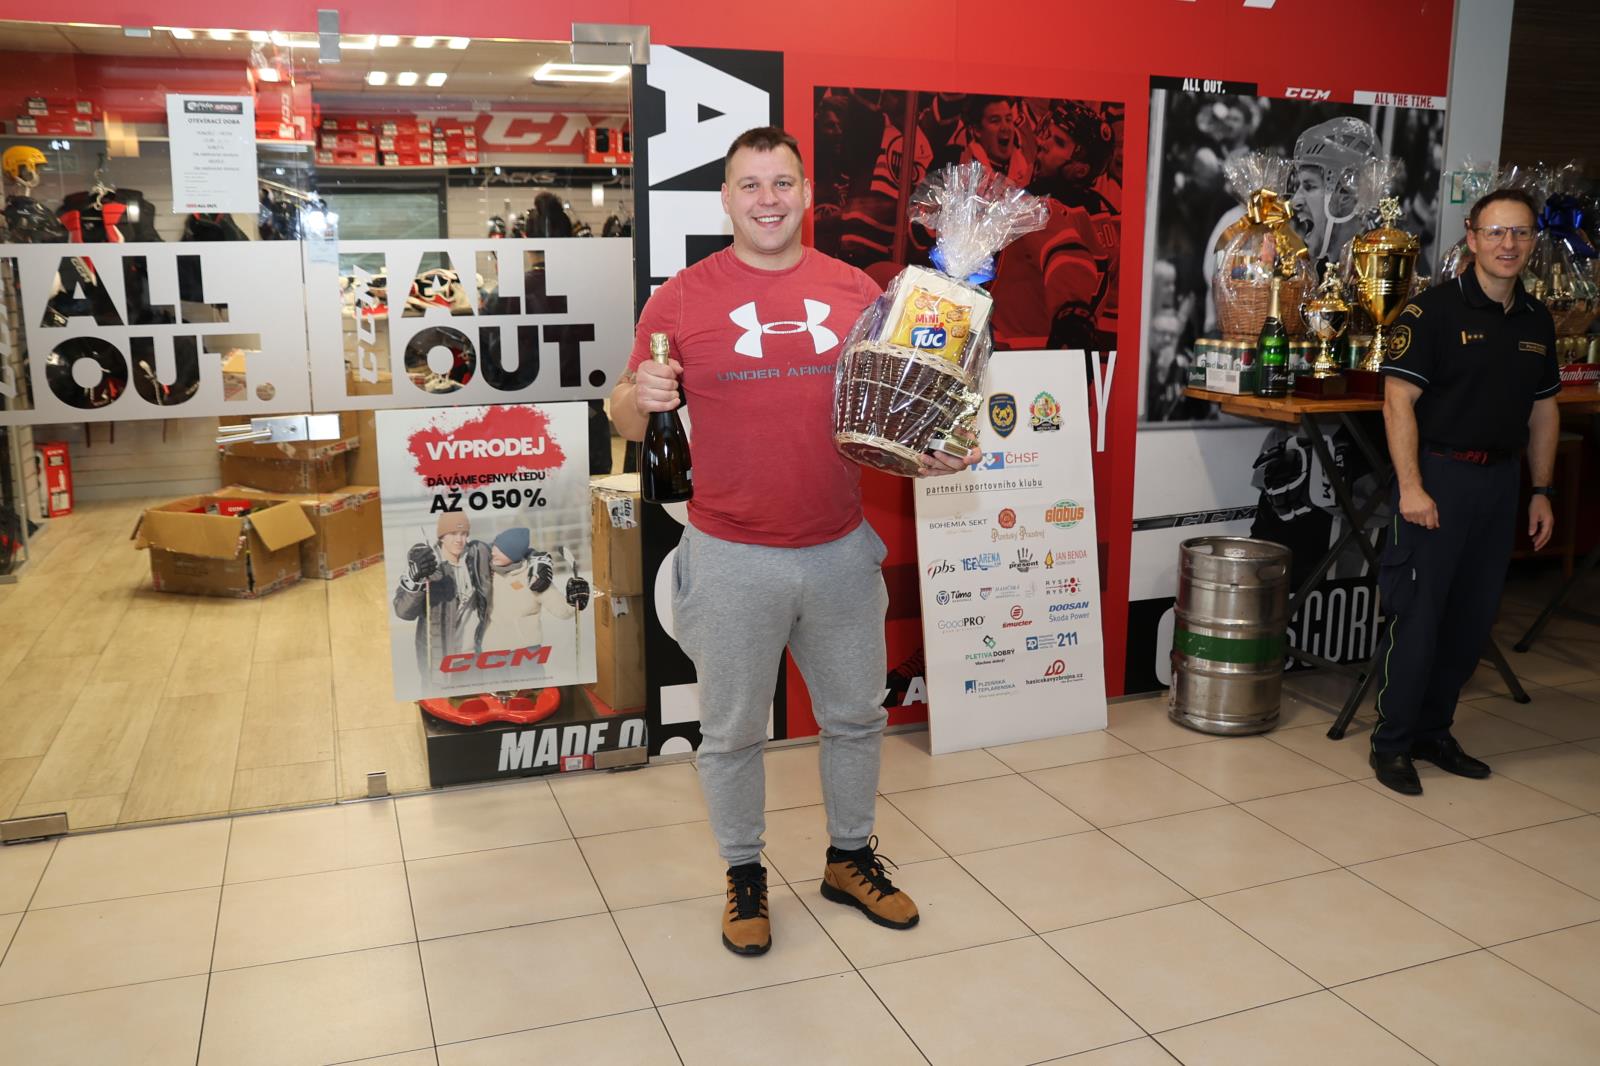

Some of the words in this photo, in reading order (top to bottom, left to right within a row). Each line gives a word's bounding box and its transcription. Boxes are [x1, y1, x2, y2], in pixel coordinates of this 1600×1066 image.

[1182, 77, 1201, 92] ALL
[1203, 79, 1226, 94] OUT.
[1284, 87, 1332, 100] CCM
[1373, 92, 1392, 106] ALL
[1393, 94, 1410, 107] THE
[1410, 95, 1435, 109] TIME.
[40, 254, 229, 328] ALL
[401, 249, 568, 318] ALL
[404, 323, 606, 394] OUT.
[45, 333, 276, 409] OUT.
[716, 366, 780, 382] UNDER
[425, 435, 546, 461] VÝPRODEJ
[1005, 452, 1040, 464] ČHSF
[427, 473, 477, 487] DÁVÁME
[478, 471, 509, 484] CENY
[509, 472, 518, 482] K
[519, 471, 546, 482] LEDU
[926, 484, 962, 497] partneři
[1019, 477, 1043, 489] klubu
[430, 488, 462, 514] AŽ
[468, 491, 488, 511] O
[492, 489, 522, 510] 50
[929, 521, 967, 530] BOHEMIA
[968, 518, 989, 527] SEKT
[1008, 560, 1039, 570] present
[1048, 601, 1090, 612] DOOSAN
[1048, 612, 1069, 623] Škoda
[1070, 610, 1090, 620] Power
[1057, 631, 1078, 647] 211
[439, 645, 552, 673] CCM
[965, 652, 993, 660] PLETIVA
